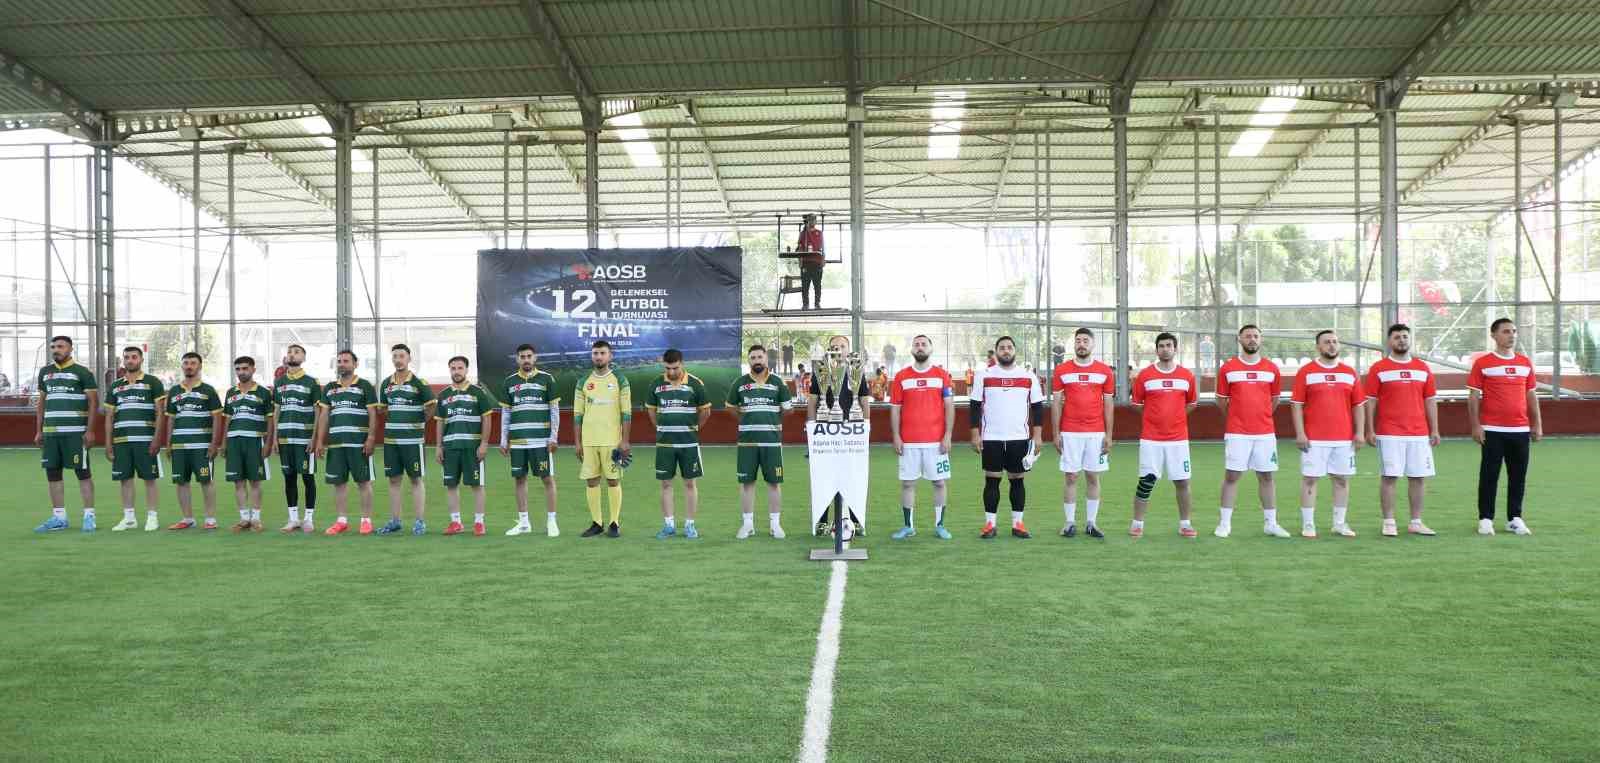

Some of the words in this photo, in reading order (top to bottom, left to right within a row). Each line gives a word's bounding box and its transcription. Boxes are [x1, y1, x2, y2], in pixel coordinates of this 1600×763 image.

[592, 264, 647, 279] AOSB
[551, 289, 608, 319] 12.
[611, 298, 669, 309] FUTBOL
[611, 311, 668, 319] TURNUVASI
[577, 320, 640, 338] FİNAL
[813, 422, 864, 435] AOSB
[936, 460, 950, 473] 26
